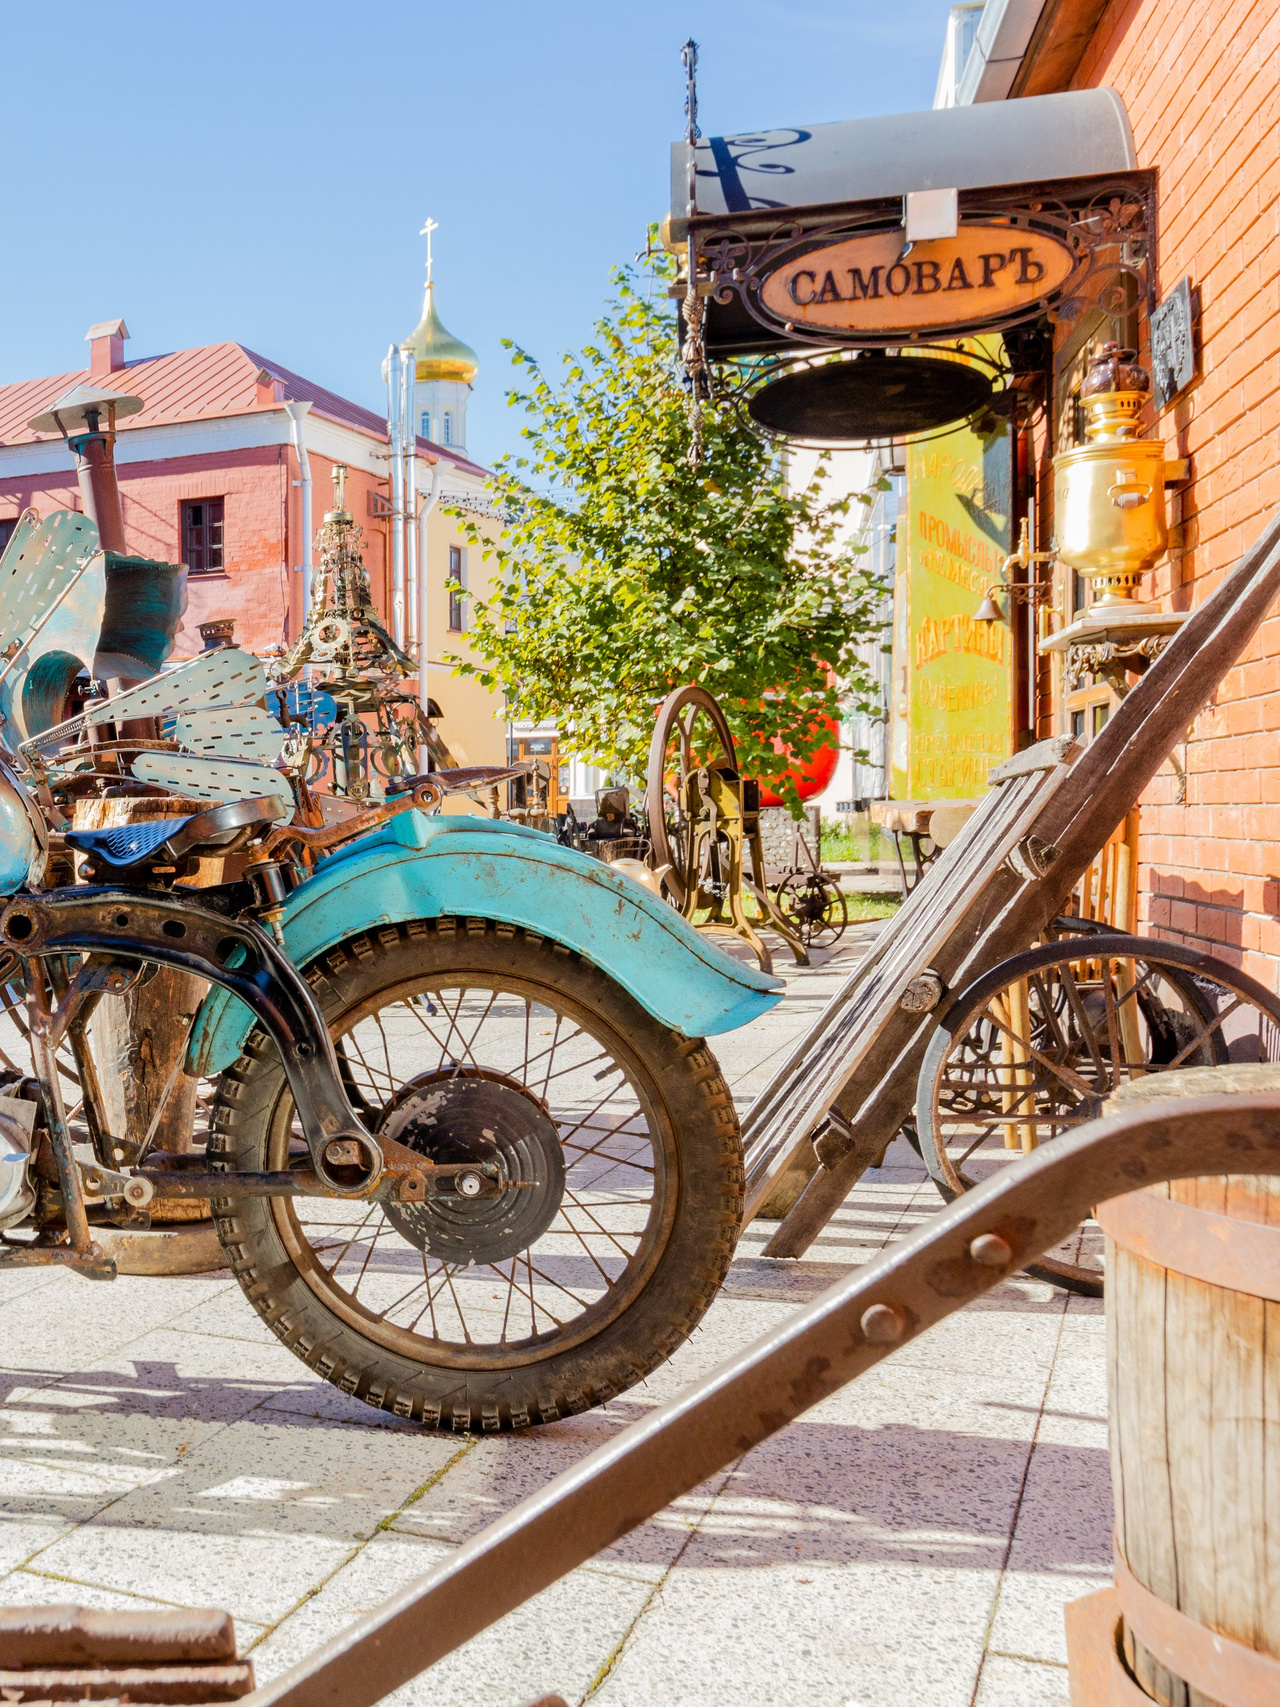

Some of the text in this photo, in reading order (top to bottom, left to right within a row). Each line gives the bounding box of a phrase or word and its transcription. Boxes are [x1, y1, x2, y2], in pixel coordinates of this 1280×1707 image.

[789, 247, 1045, 306] САМОВАРЪ
[919, 511, 998, 577] ПРОМЫСЛЫ
[915, 613, 1005, 670] КАРТИНЫ
